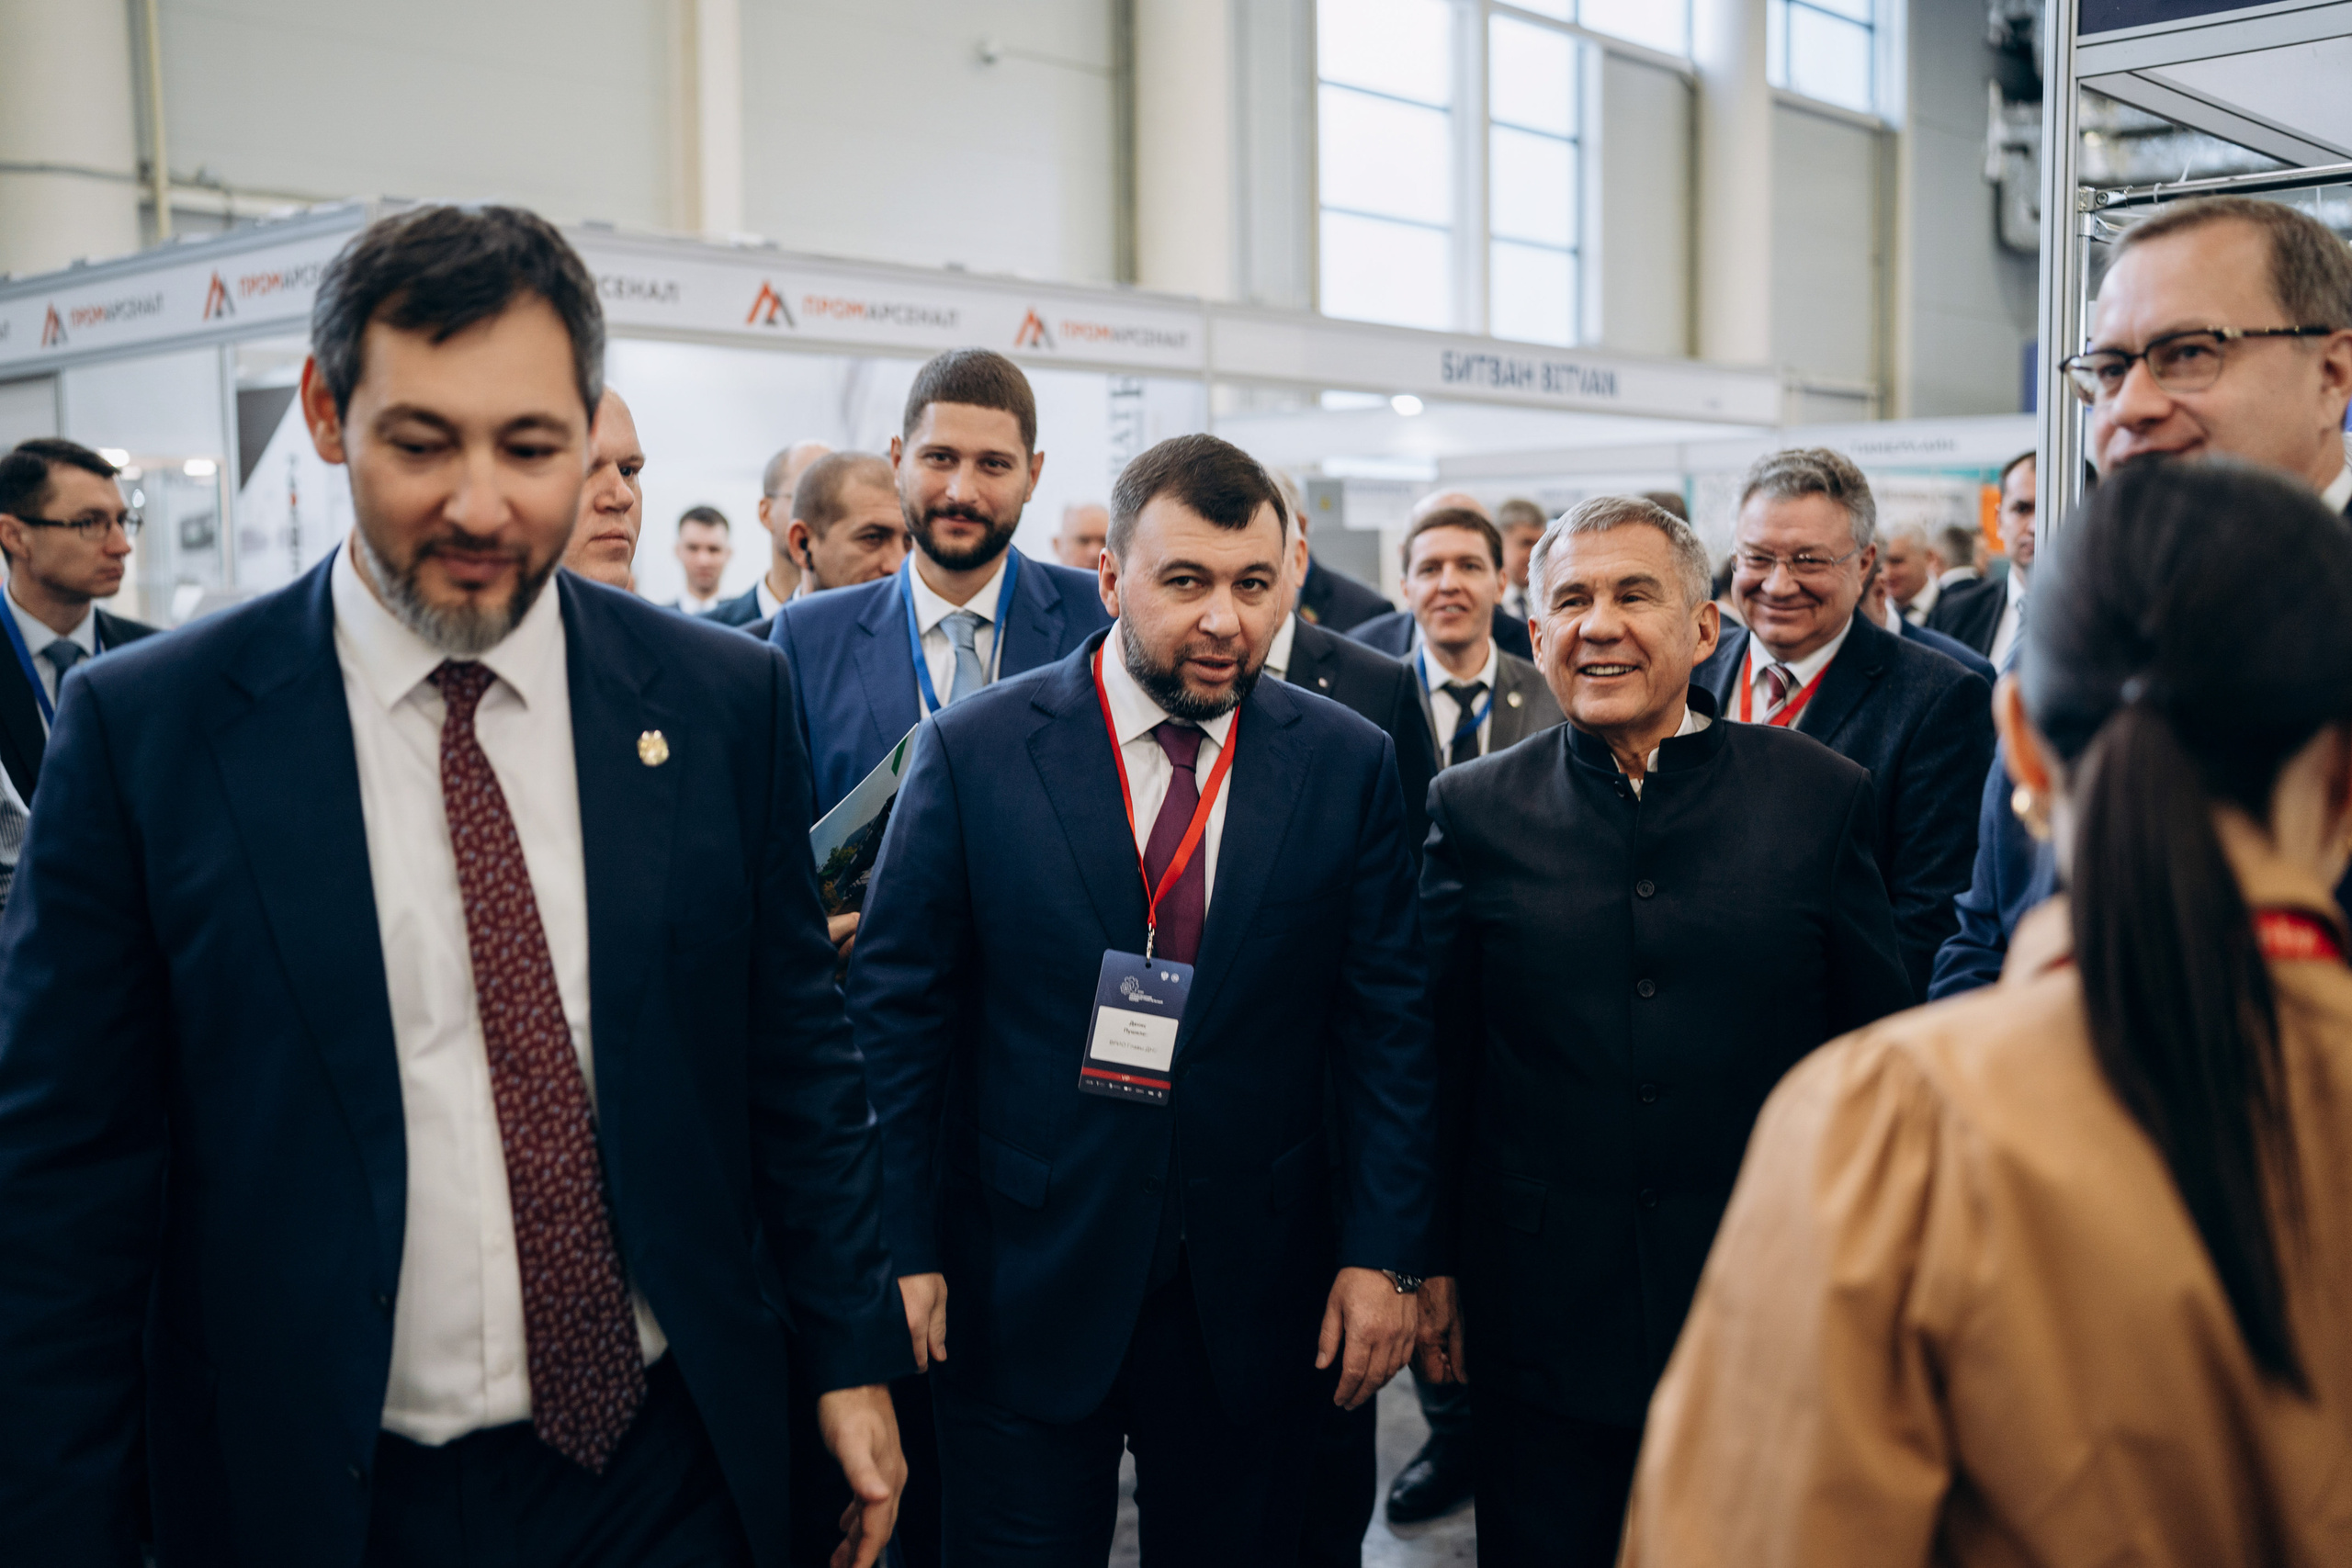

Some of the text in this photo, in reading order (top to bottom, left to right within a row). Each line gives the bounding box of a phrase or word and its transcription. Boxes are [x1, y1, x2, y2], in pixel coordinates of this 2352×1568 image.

[239, 264, 322, 299] ПРОМАРСЕ
[599, 275, 680, 304] СЕНАЛ
[802, 294, 960, 330] ПРОМАРСЕНАЛ
